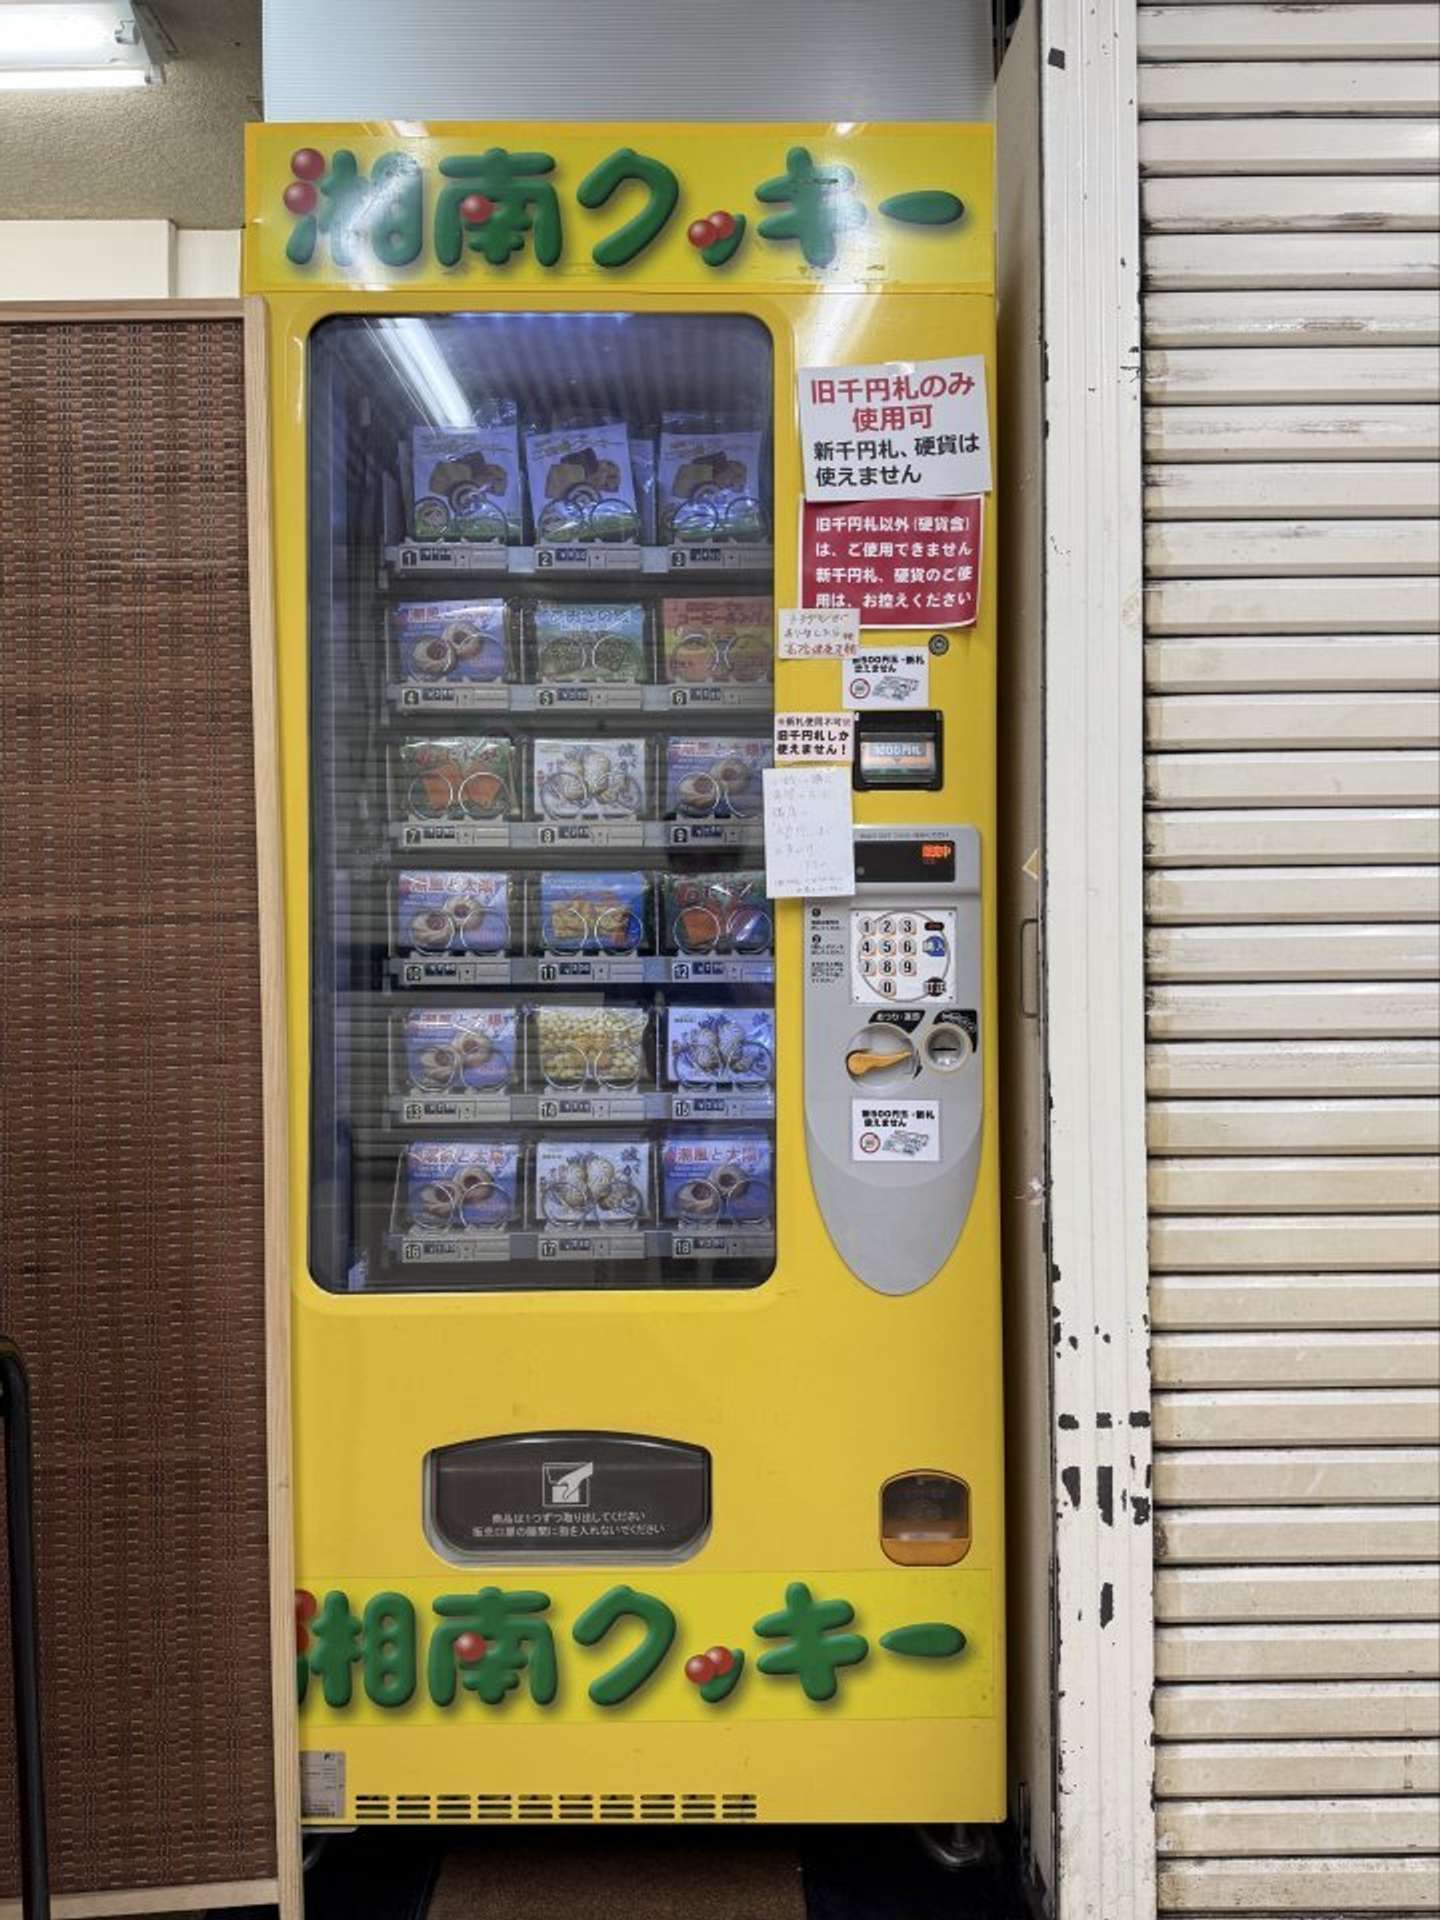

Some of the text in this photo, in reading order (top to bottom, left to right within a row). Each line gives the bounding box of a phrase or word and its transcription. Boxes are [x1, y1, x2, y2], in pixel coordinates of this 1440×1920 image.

[283, 146, 964, 268] 湘南クッキー
[811, 371, 975, 404] 旧千円札のみ
[852, 404, 933, 432] 使用可
[813, 433, 980, 462] 新千円札、硬貨は
[816, 464, 922, 487] 使えません
[815, 542, 973, 558] は、ご使用できません
[815, 566, 973, 583] 新千円札、硬貨のご使
[815, 592, 972, 608] 用は、お控えください
[778, 730, 848, 741] 旧千円札しか
[864, 922, 870, 932] 1
[884, 922, 891, 932] 2
[904, 922, 911, 932] 3
[864, 943, 870, 953] 4
[884, 943, 891, 953] 5
[904, 943, 911, 953] 6
[864, 962, 870, 972] 7
[884, 962, 891, 972] 8
[904, 962, 911, 972] 9
[884, 983, 891, 993] 0
[296, 1582, 967, 1708] 湘南クッキー
